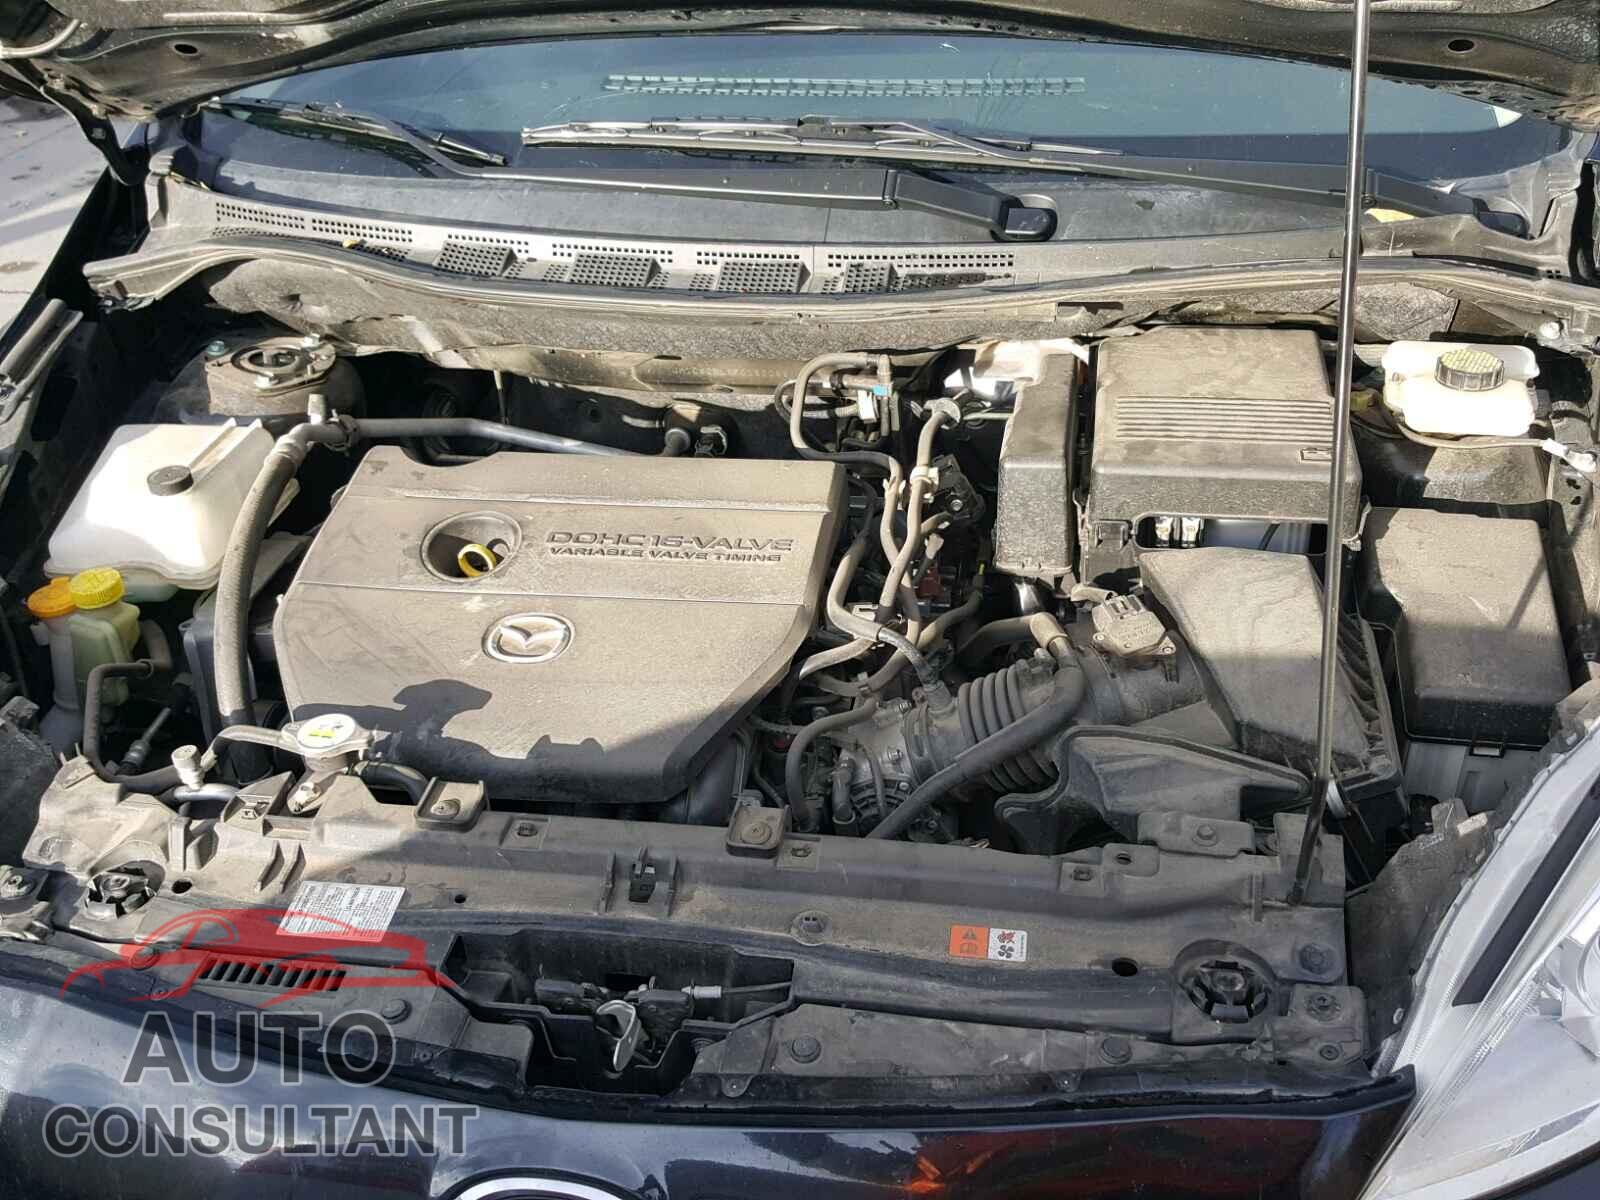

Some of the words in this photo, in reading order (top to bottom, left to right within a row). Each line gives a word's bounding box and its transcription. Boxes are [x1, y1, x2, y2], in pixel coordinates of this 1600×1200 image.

[546, 531, 646, 546] DOHC
[650, 534, 794, 552] 16-VALVE
[549, 546, 644, 558] VARIABLE
[648, 549, 708, 561] VALVE
[713, 552, 781, 562] TIMING
